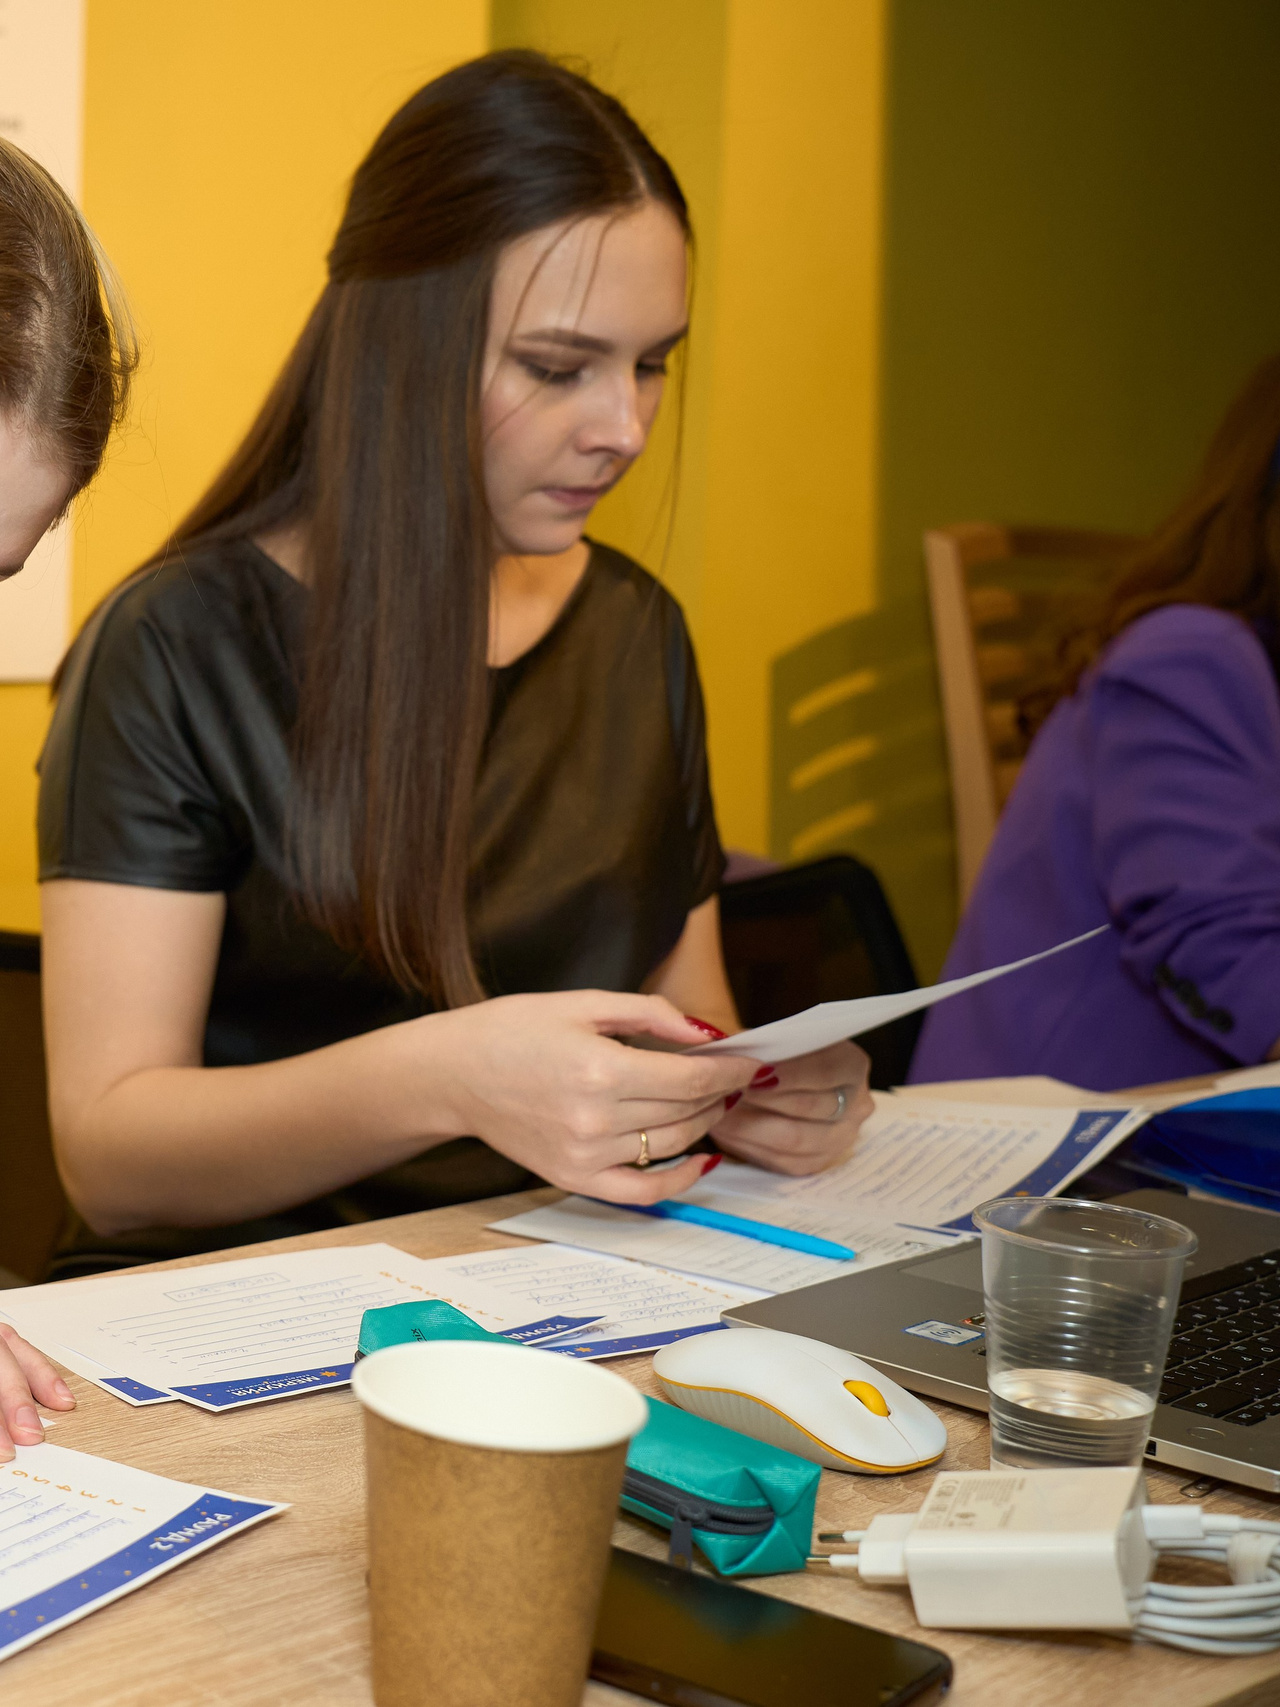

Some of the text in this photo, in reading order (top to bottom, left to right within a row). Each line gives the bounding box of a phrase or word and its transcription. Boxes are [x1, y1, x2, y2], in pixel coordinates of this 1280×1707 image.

[230, 1375, 321, 1397] МЕРКУРИЯ
[12, 1470, 28, 1478] 6
[33, 1475, 50, 1485] 5
[55, 1484, 72, 1493] 4
[80, 1490, 99, 1499] 3
[106, 1498, 123, 1506] 2
[149, 1513, 232, 1551] РАУНД 2
